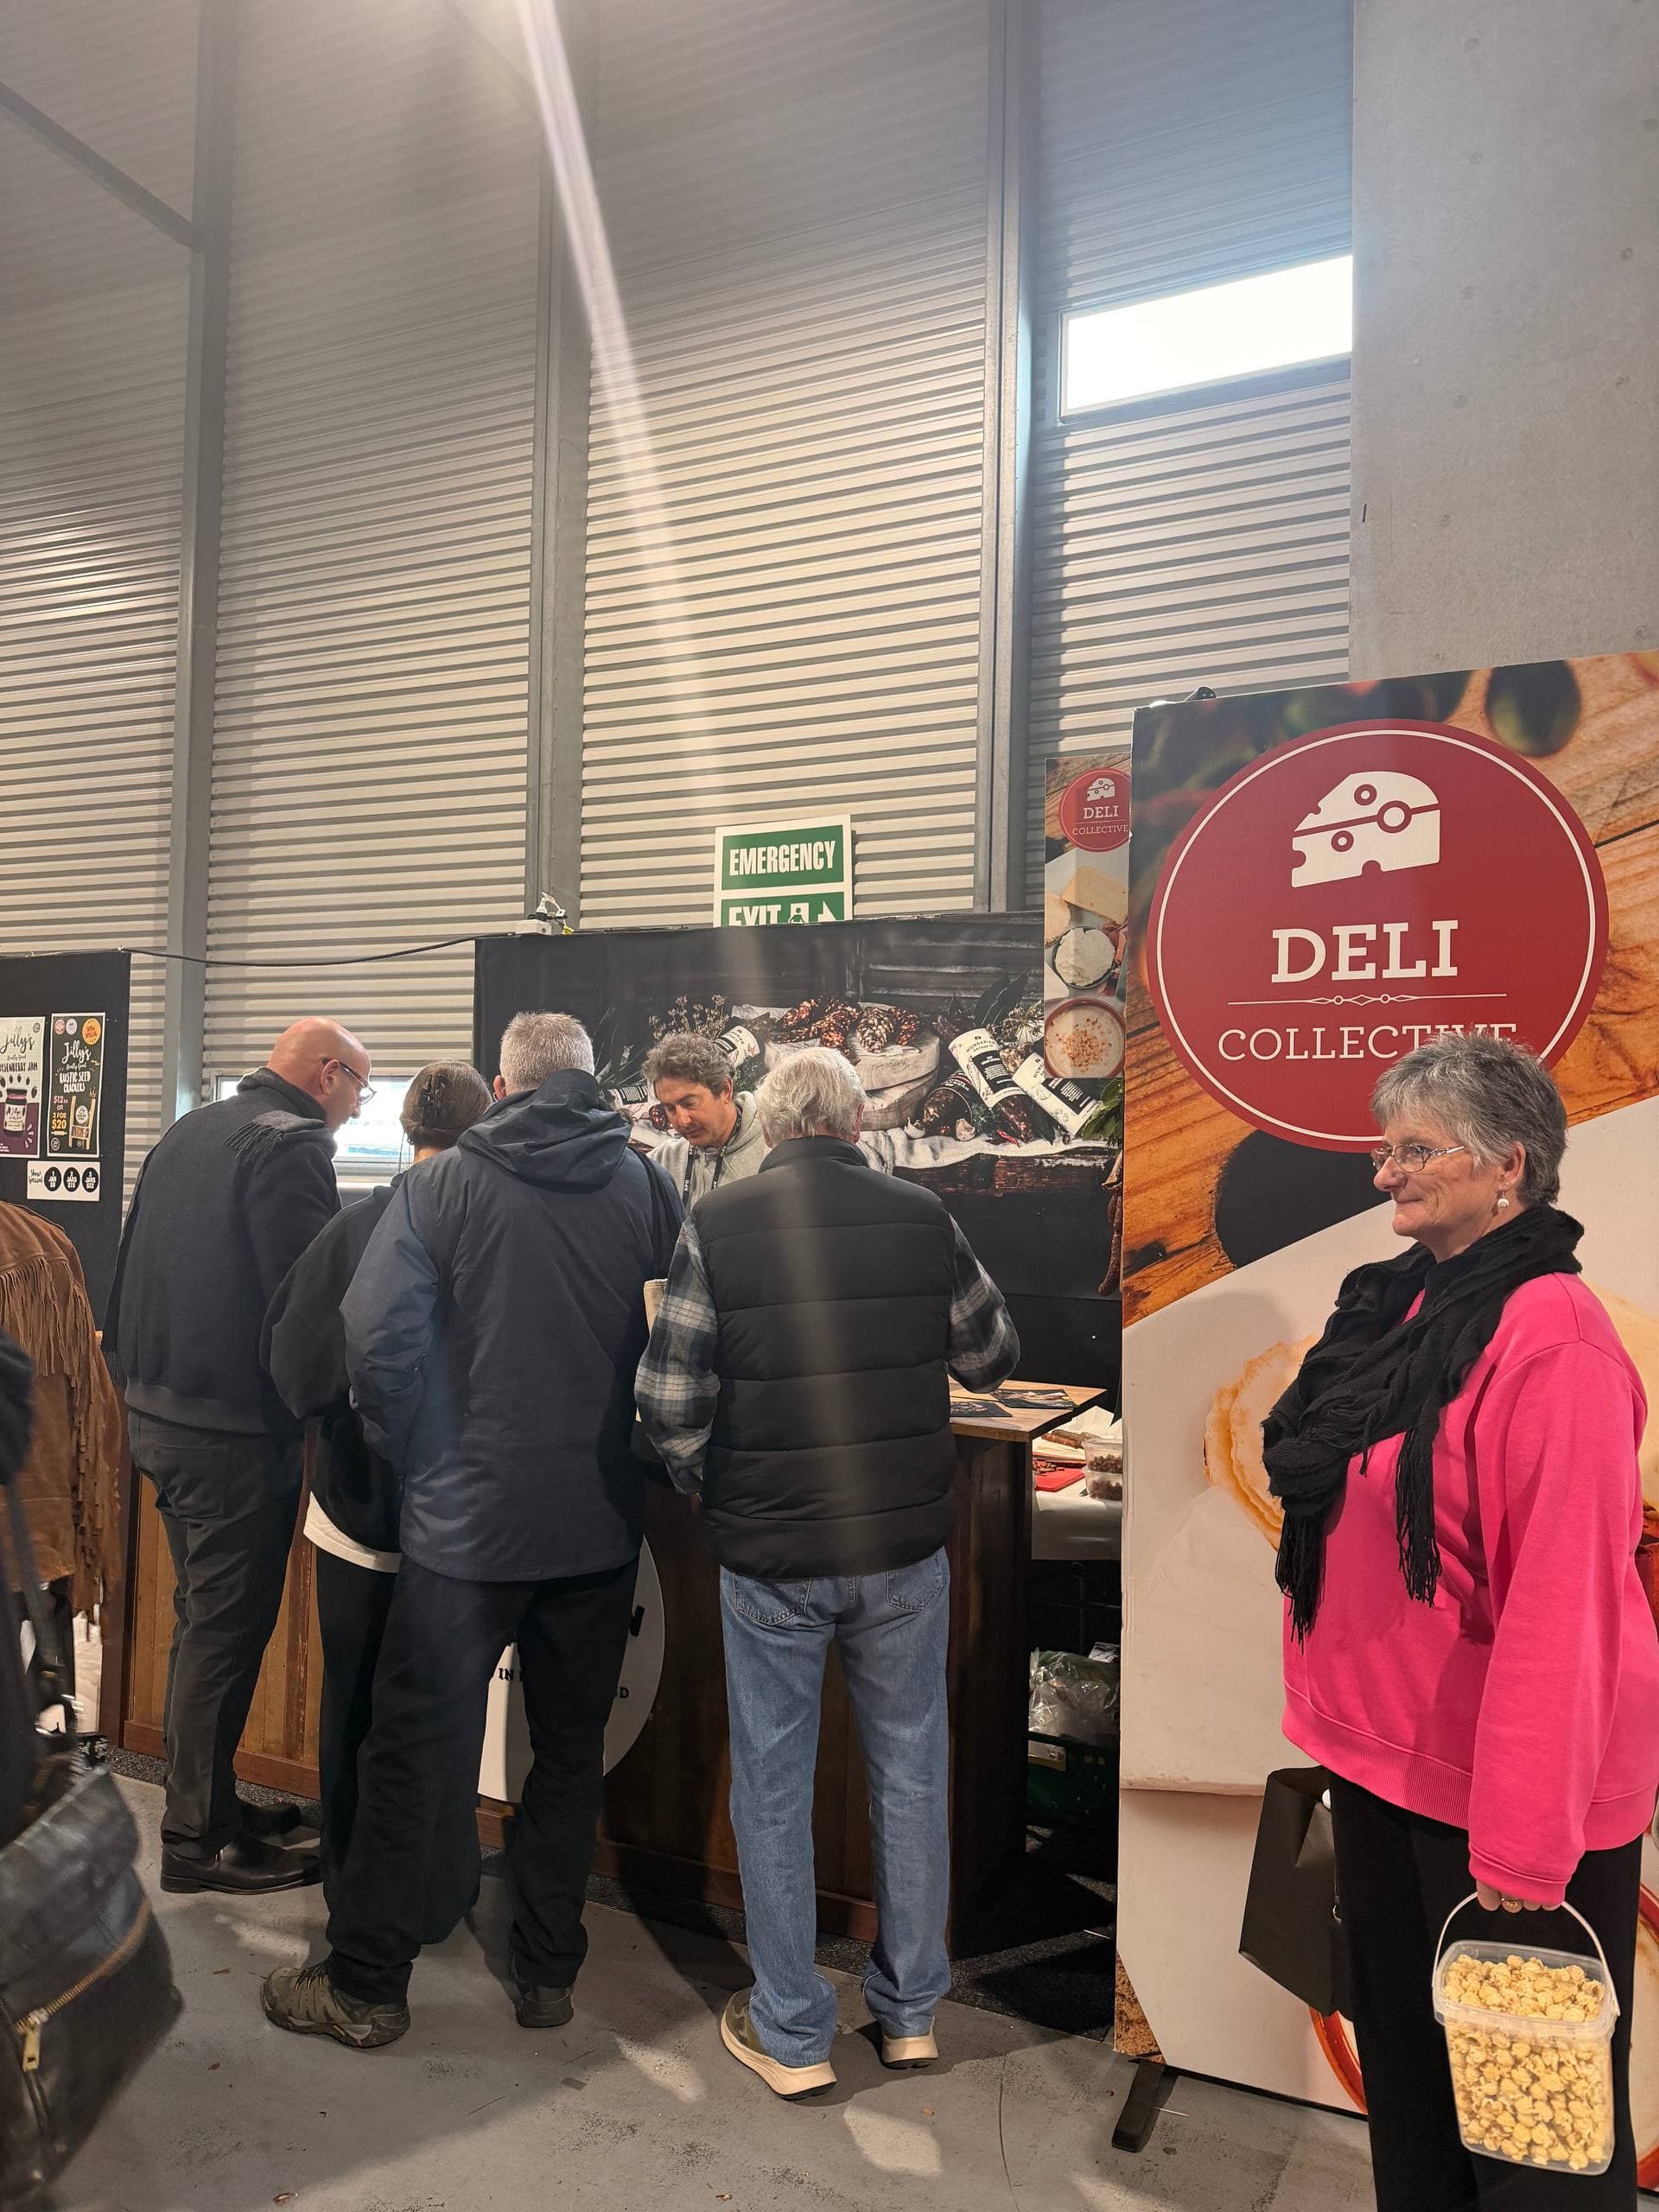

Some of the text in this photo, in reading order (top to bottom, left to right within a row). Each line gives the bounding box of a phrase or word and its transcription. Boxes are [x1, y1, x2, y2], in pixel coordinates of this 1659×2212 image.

[1084, 805, 1119, 819] DELI
[1072, 824, 1128, 836] COLLECTIVE
[729, 841, 836, 876] EMERGENCY
[728, 904, 782, 926] EXIT
[1271, 919, 1459, 983] DELI
[61, 1040, 92, 1064] Jilly's
[28, 1061, 38, 1071] JAM
[79, 1071, 91, 1082] SEED
[52, 1119, 67, 1130] $20
